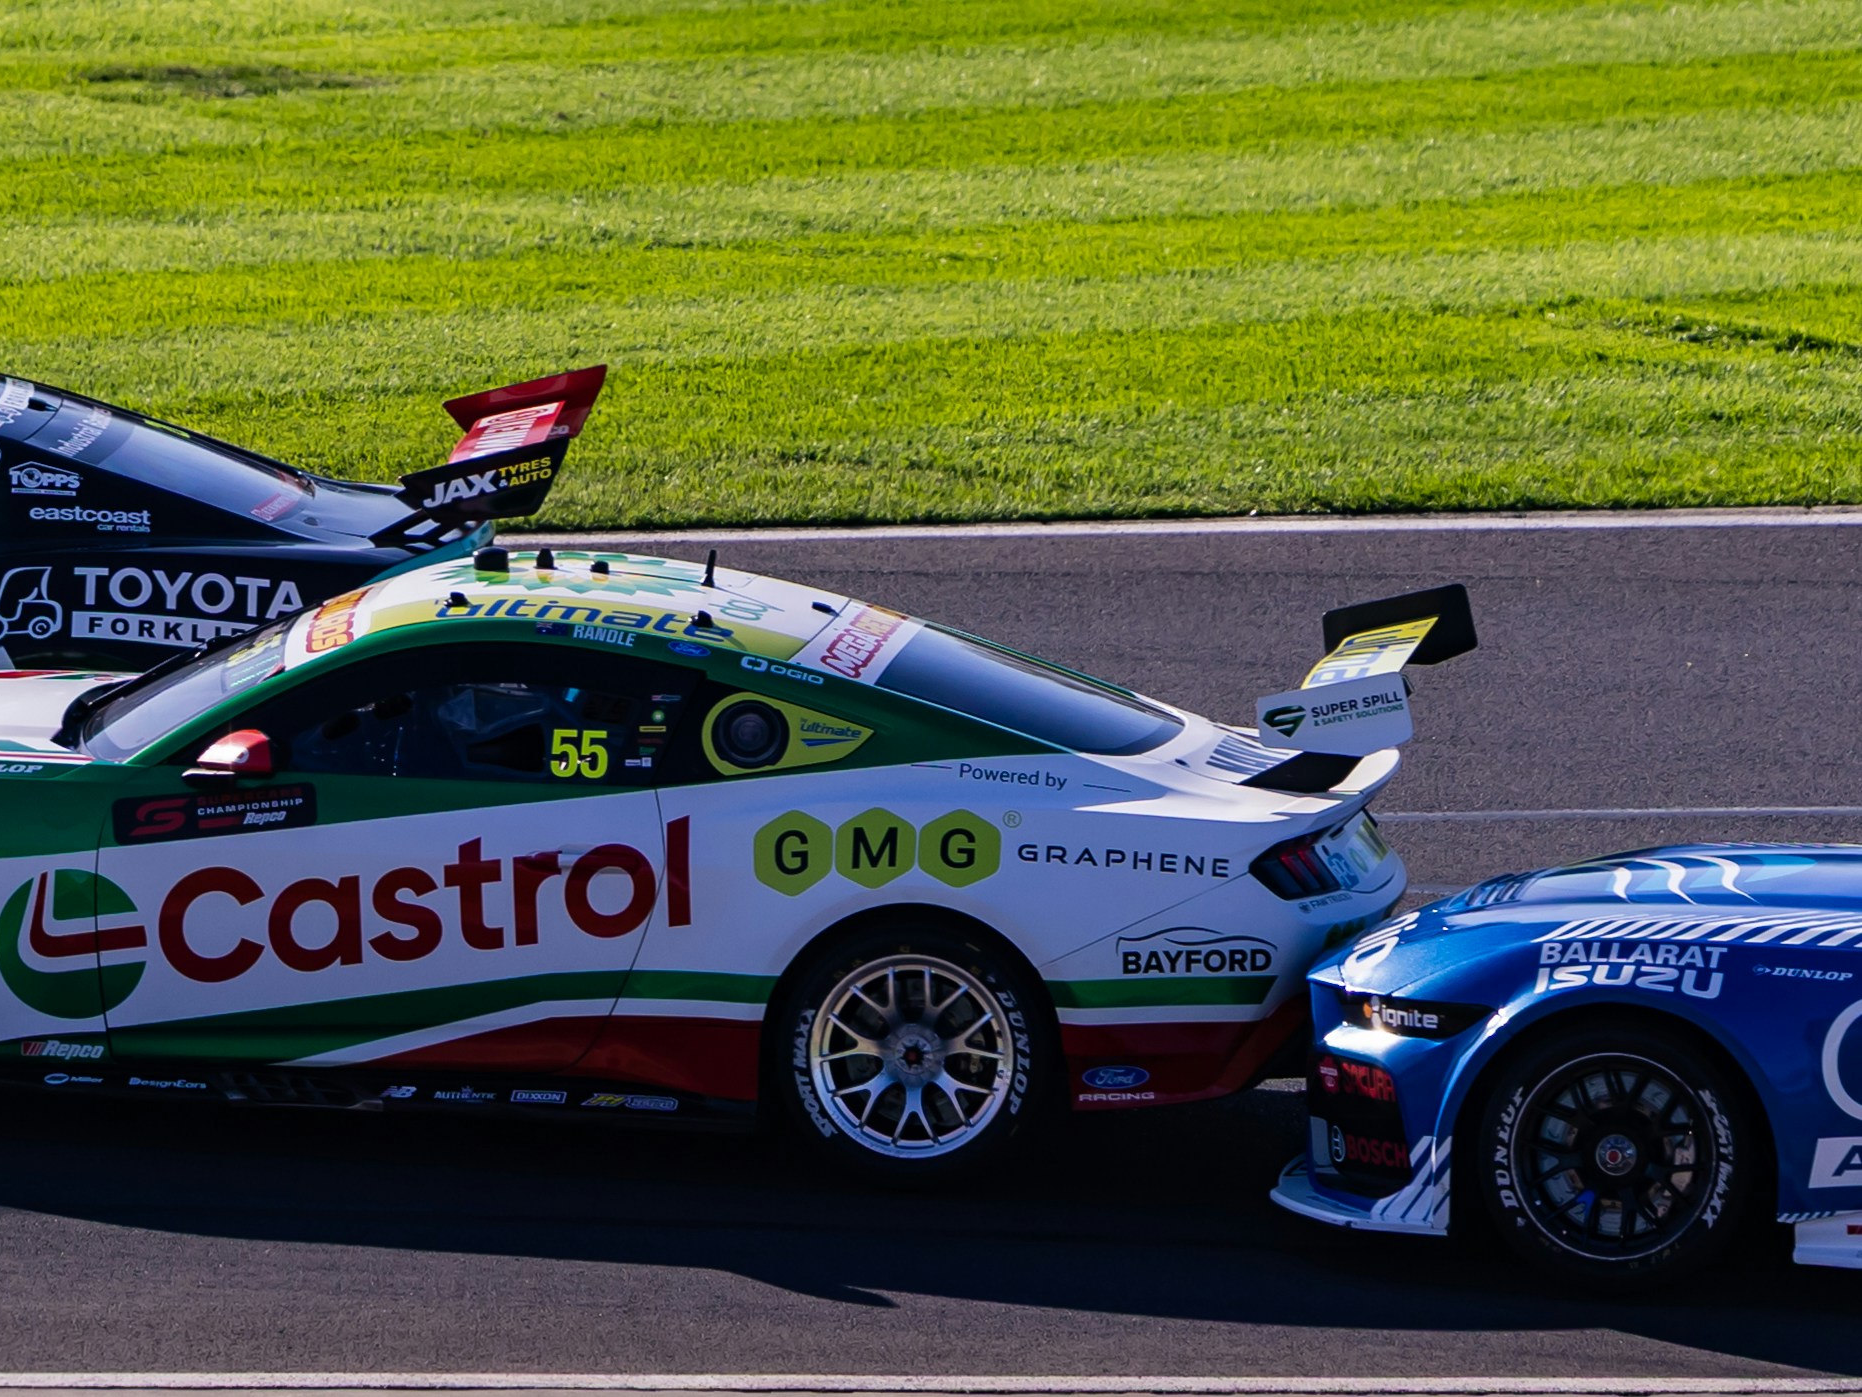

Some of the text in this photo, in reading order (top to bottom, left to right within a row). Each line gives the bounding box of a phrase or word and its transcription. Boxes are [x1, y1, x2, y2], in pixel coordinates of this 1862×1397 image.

[9, 467, 81, 489] TOPPS
[499, 457, 552, 478] TYRES
[509, 468, 553, 488] AUTO
[422, 470, 498, 508] JAX
[29, 506, 151, 525] eastcoast
[97, 524, 114, 532] car
[74, 566, 304, 620] TOYOTA
[89, 617, 247, 644] FORKL
[573, 624, 636, 648] RANDLE
[672, 641, 706, 656] Ford
[770, 664, 825, 686] OGIO
[1312, 690, 1403, 718] SUPER SPILL
[800, 721, 863, 739] ultimate
[1322, 714, 1353, 726] SAFETY
[549, 728, 608, 779] 55
[959, 763, 1068, 792] Powered by
[197, 797, 304, 816] CHAMPIONSHIP
[243, 810, 287, 826] Repco
[1018, 843, 1230, 878] GRAPHENE
[158, 814, 692, 984] Castrol
[1122, 947, 1272, 975] BAYFORD
[1539, 942, 1728, 969] BALLARAT
[1533, 963, 1725, 1000] ISUZU
[1772, 966, 1853, 981] DUNLOP
[1381, 1004, 1440, 1030] ignite
[41, 1039, 105, 1060] Repco
[995, 989, 1032, 1116] DUNLOP
[792, 1008, 839, 1139] SPORT MAXX
[1089, 1066, 1142, 1088] Ford
[1079, 1091, 1155, 1102] RACING
[1345, 1134, 1410, 1169] BOSCH
